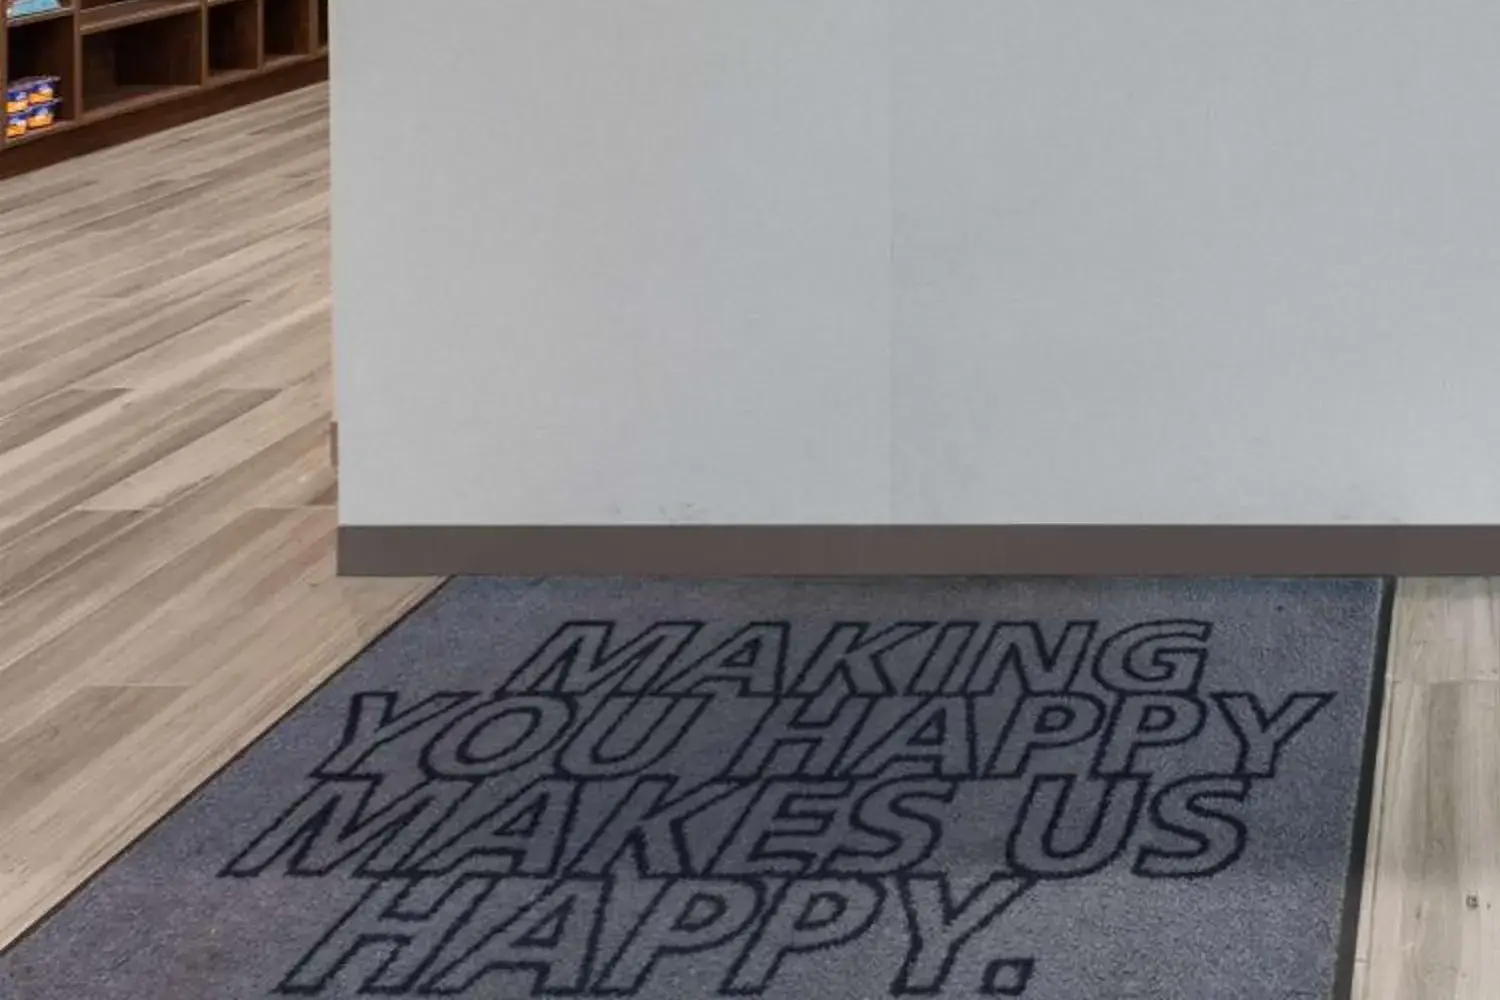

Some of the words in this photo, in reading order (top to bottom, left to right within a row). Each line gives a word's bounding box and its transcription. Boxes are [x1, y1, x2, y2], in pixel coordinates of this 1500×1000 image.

[496, 620, 1213, 697] MAKING
[310, 690, 714, 781] YOU
[716, 690, 1338, 781] HAPPY
[215, 773, 960, 880] MAKES
[1004, 772, 1253, 880] US
[270, 872, 1041, 997] HAPPY.
